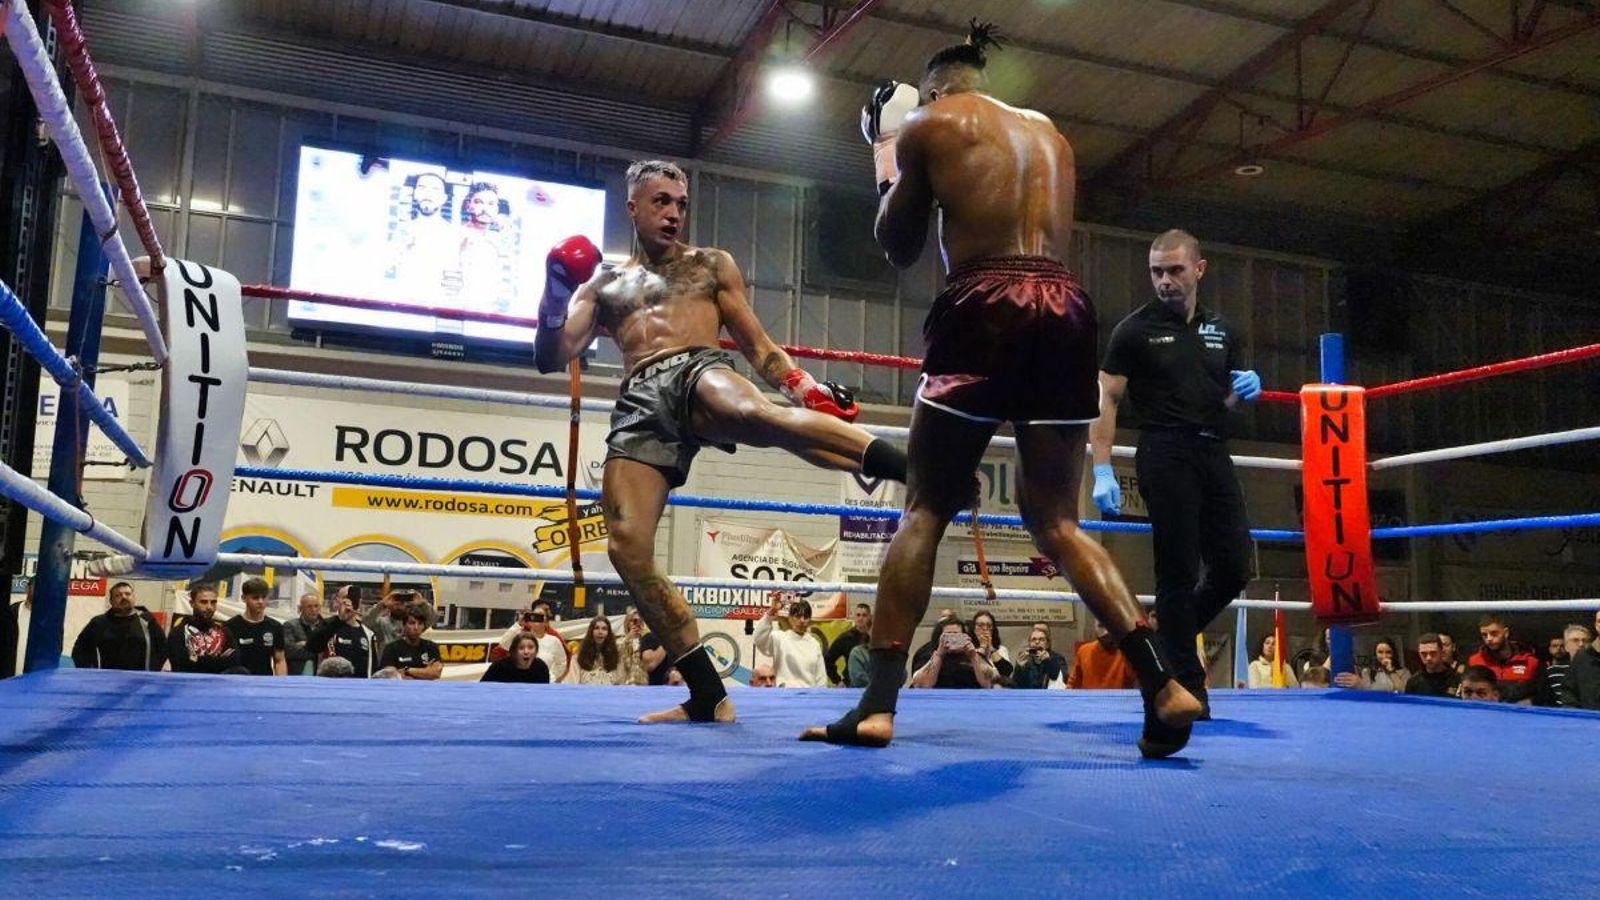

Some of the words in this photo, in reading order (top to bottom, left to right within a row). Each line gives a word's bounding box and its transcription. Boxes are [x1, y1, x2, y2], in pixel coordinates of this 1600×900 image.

[335, 425, 563, 477] RODOSA
[367, 495, 533, 516] www.rodosa.com
[731, 554, 767, 563] AGENCIA
[768, 557, 779, 565] DE
